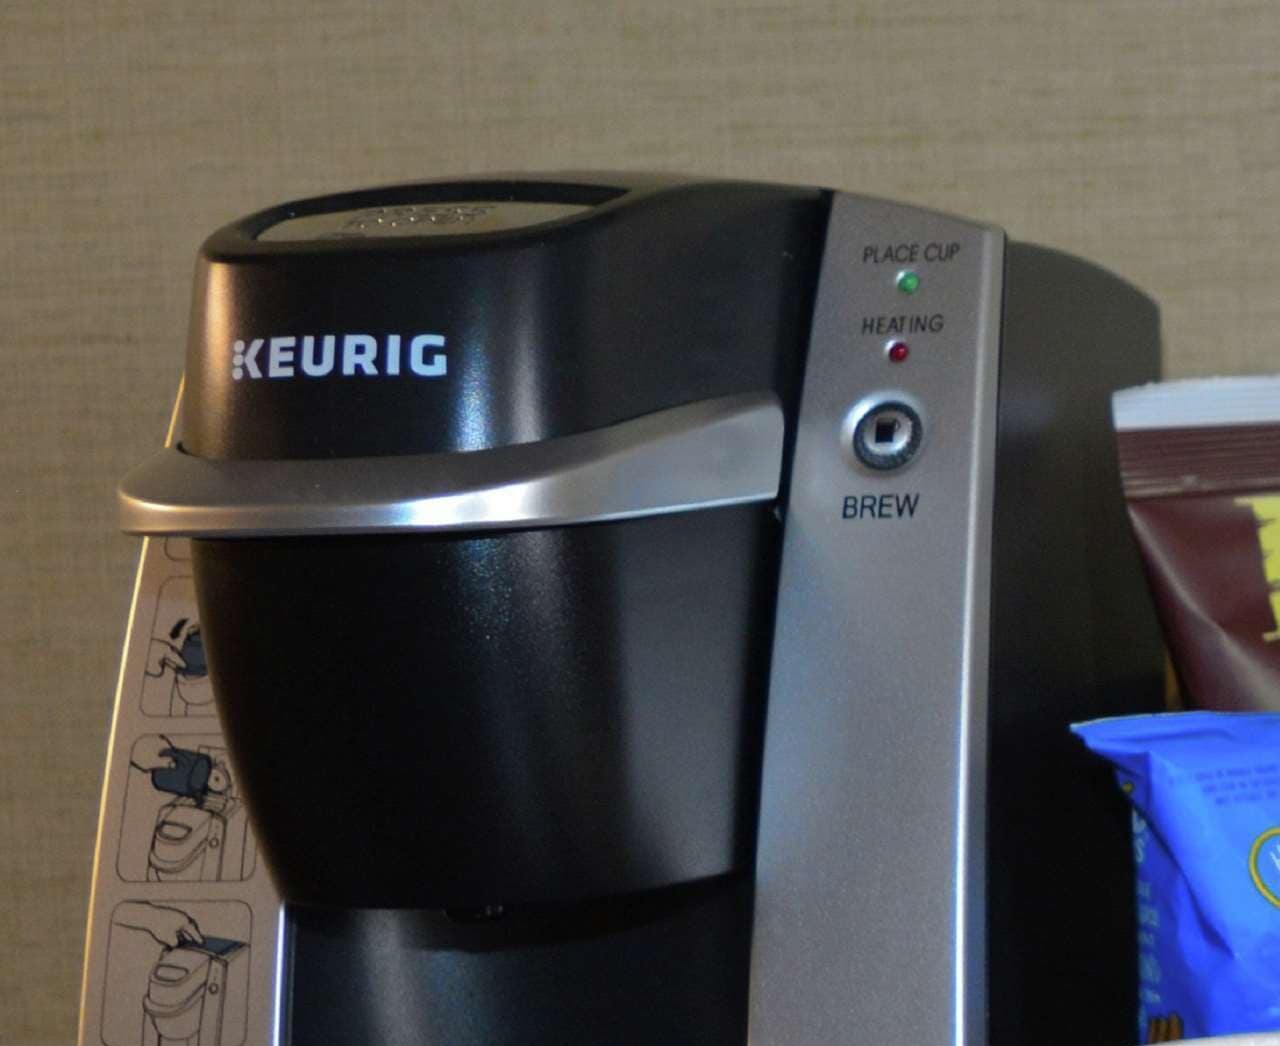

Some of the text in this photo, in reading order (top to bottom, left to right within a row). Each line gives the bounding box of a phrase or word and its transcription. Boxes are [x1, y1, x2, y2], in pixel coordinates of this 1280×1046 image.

[862, 243, 960, 264] PLACE CUP
[862, 315, 944, 334] HEATING
[232, 334, 447, 380] KEURIG
[842, 495, 920, 520] BREW
